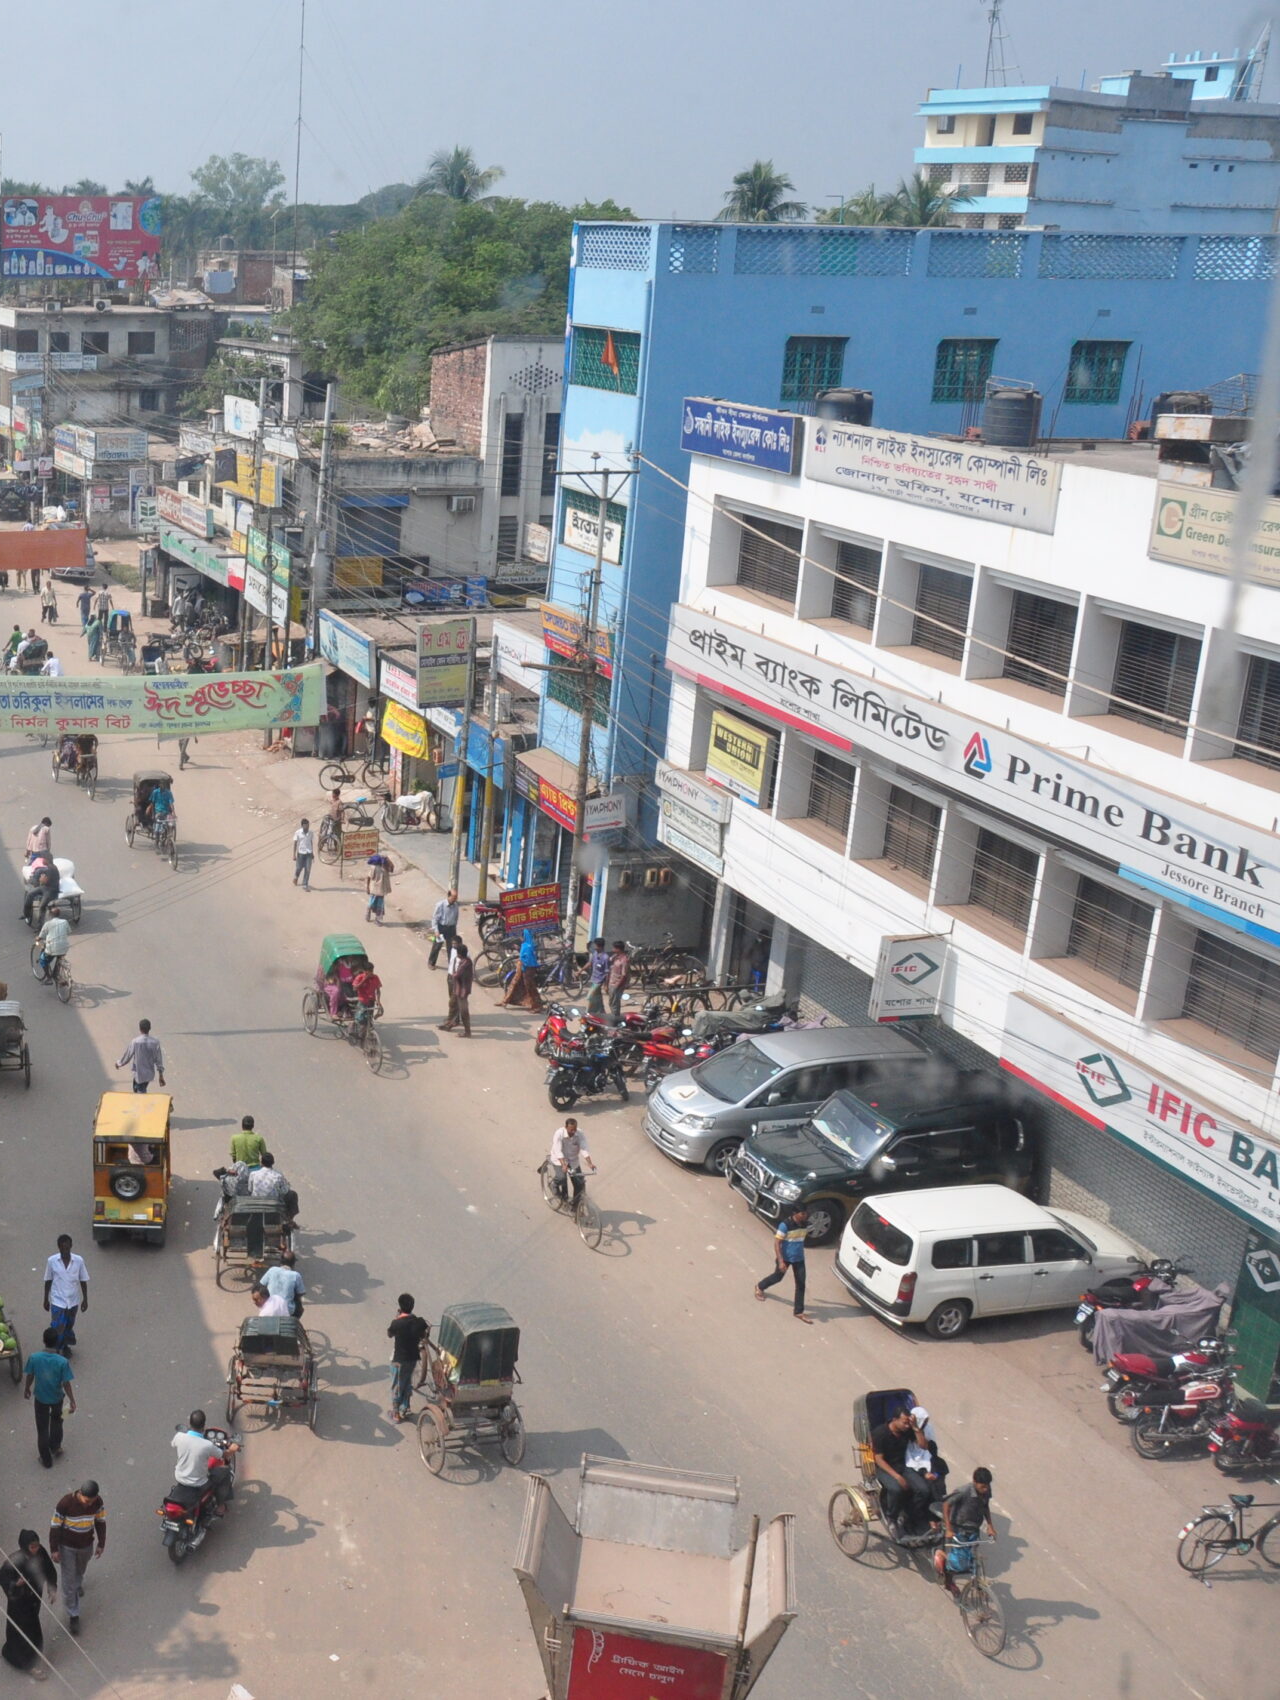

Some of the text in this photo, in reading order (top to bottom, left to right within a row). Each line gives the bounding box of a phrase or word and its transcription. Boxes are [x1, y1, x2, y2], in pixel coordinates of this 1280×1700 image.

[832, 429, 873, 453] ন্যাশনাল
[876, 435, 906, 458] লাইফ
[967, 455, 1022, 481] কোম্পানী
[1025, 459, 1048, 487] লিঃ
[834, 464, 889, 485] জোনাল
[958, 492, 1016, 514] যশোর
[1185, 526, 1215, 544] Green
[12, 691, 52, 713] তরিকুল
[54, 691, 105, 711] ইসলামের
[144, 681, 193, 721] ঈদ
[688, 628, 950, 752] প্রাইম ব্যাংক লিমিটেড
[10, 714, 49, 729] নির্মল
[55, 716, 100, 732] কুমার
[716, 727, 754, 754] WESTERN
[726, 743, 753, 763] UNION
[1005, 753, 1267, 890] Prime Bank
[1161, 864, 1265, 919] Jessore Branch
[890, 965, 917, 973] IFIC
[1075, 1060, 1107, 1087] IFIC
[1146, 1083, 1219, 1148] IFIC
[611, 1653, 685, 1677] ট্রাফিক আইন
[619, 1666, 675, 1685] মেনে চলুন
